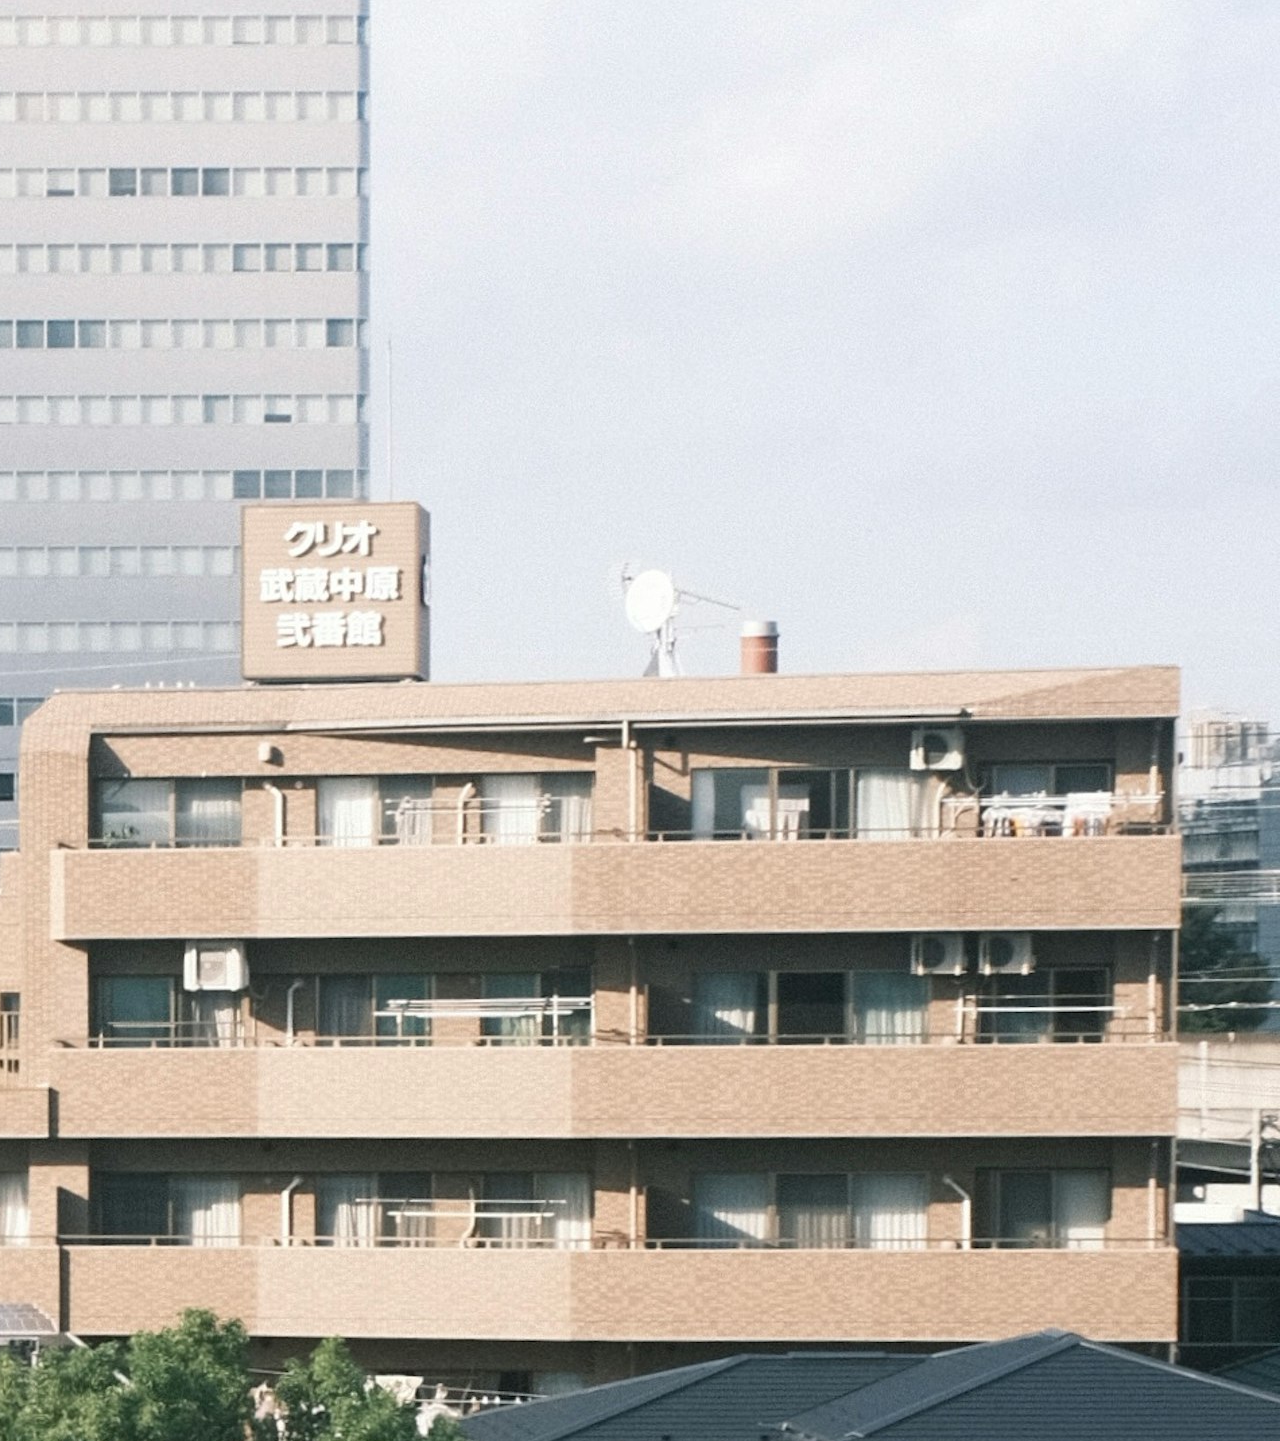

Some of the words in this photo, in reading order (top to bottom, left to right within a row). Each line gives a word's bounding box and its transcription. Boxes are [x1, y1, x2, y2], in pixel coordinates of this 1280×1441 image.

[284, 519, 378, 558] クリオ
[259, 566, 401, 603] 武蔵中原
[276, 609, 383, 648] 弐番館
